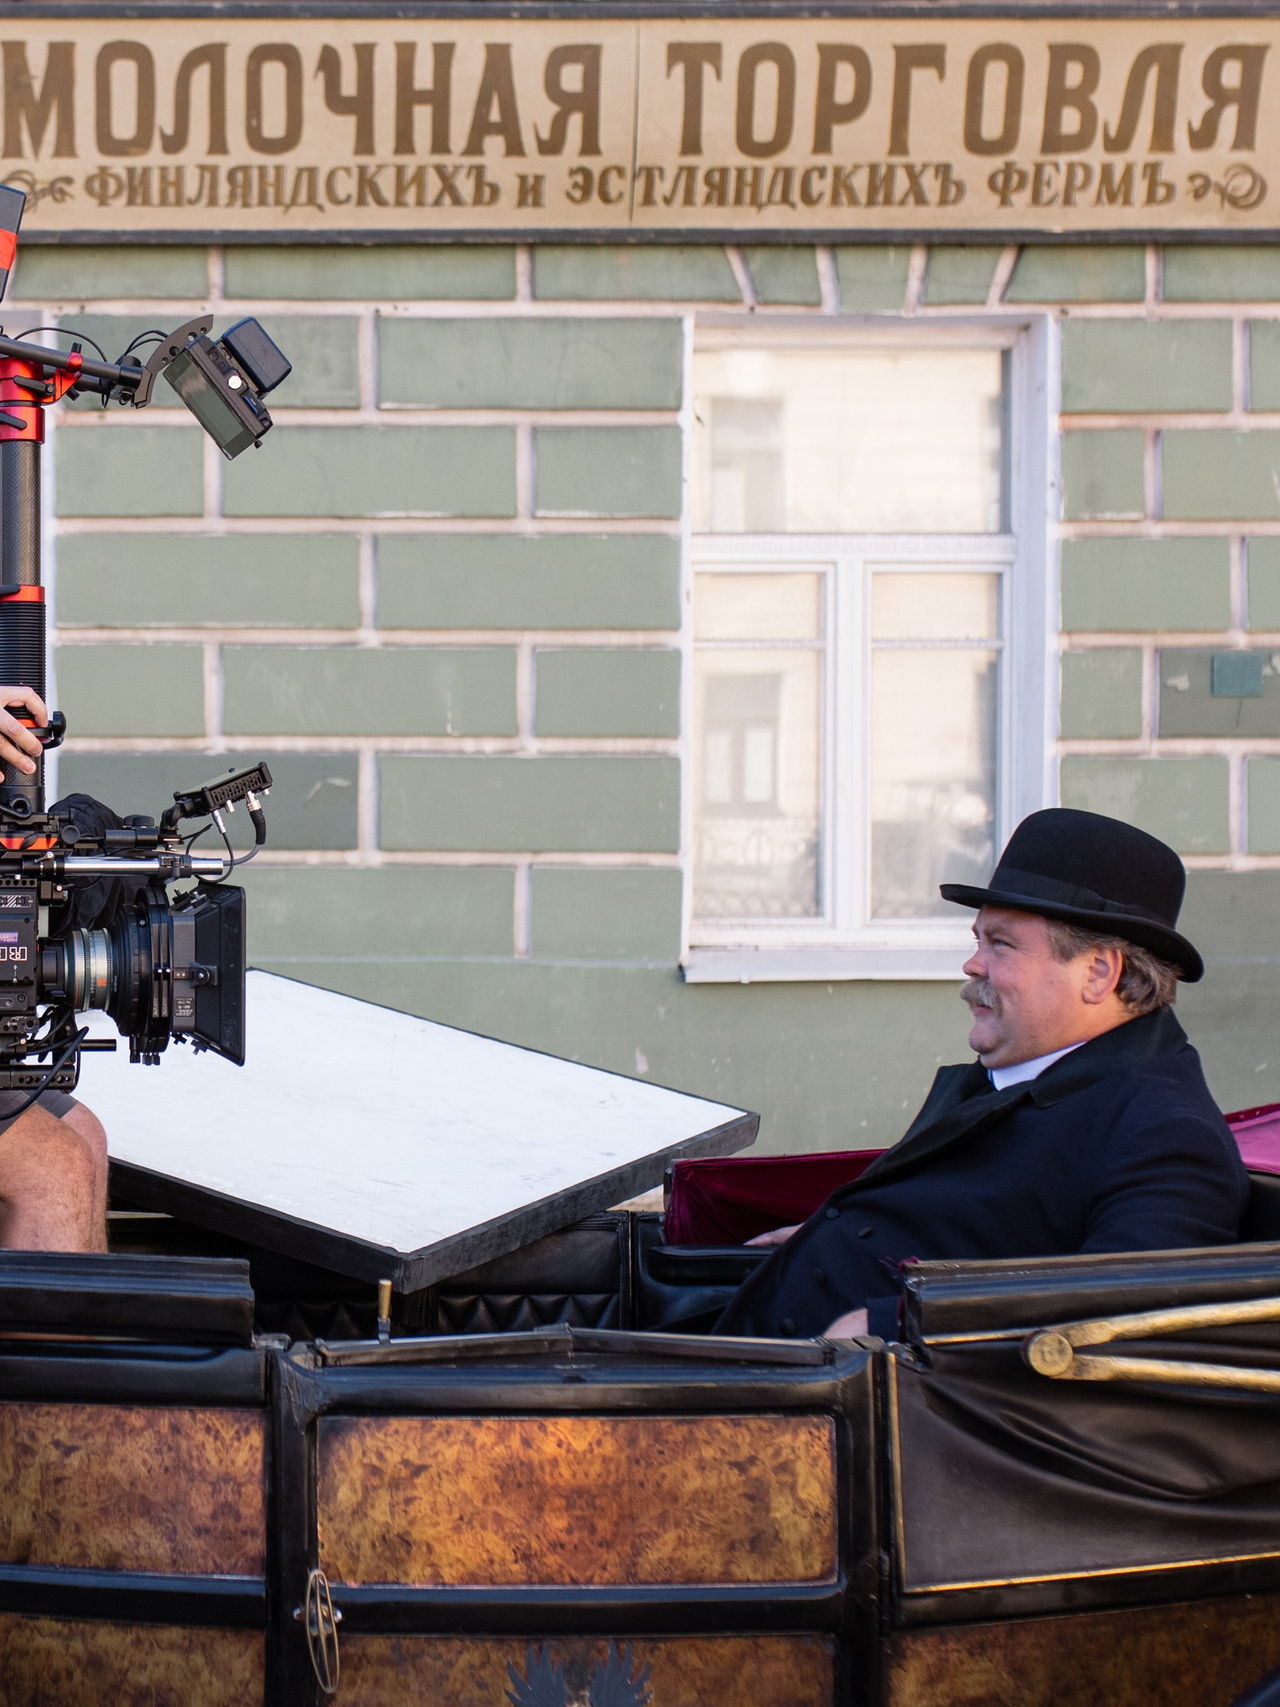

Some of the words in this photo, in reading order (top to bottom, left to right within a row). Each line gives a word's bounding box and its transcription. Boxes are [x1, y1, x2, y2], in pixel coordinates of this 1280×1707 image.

[1, 40, 603, 160] МОЛОЧНАЯ
[666, 41, 1271, 159] ТОРГОВЛЯ
[84, 163, 501, 211] ФИНЛЯНДСКИХЪ
[987, 160, 1177, 209] ФЕРМЪ
